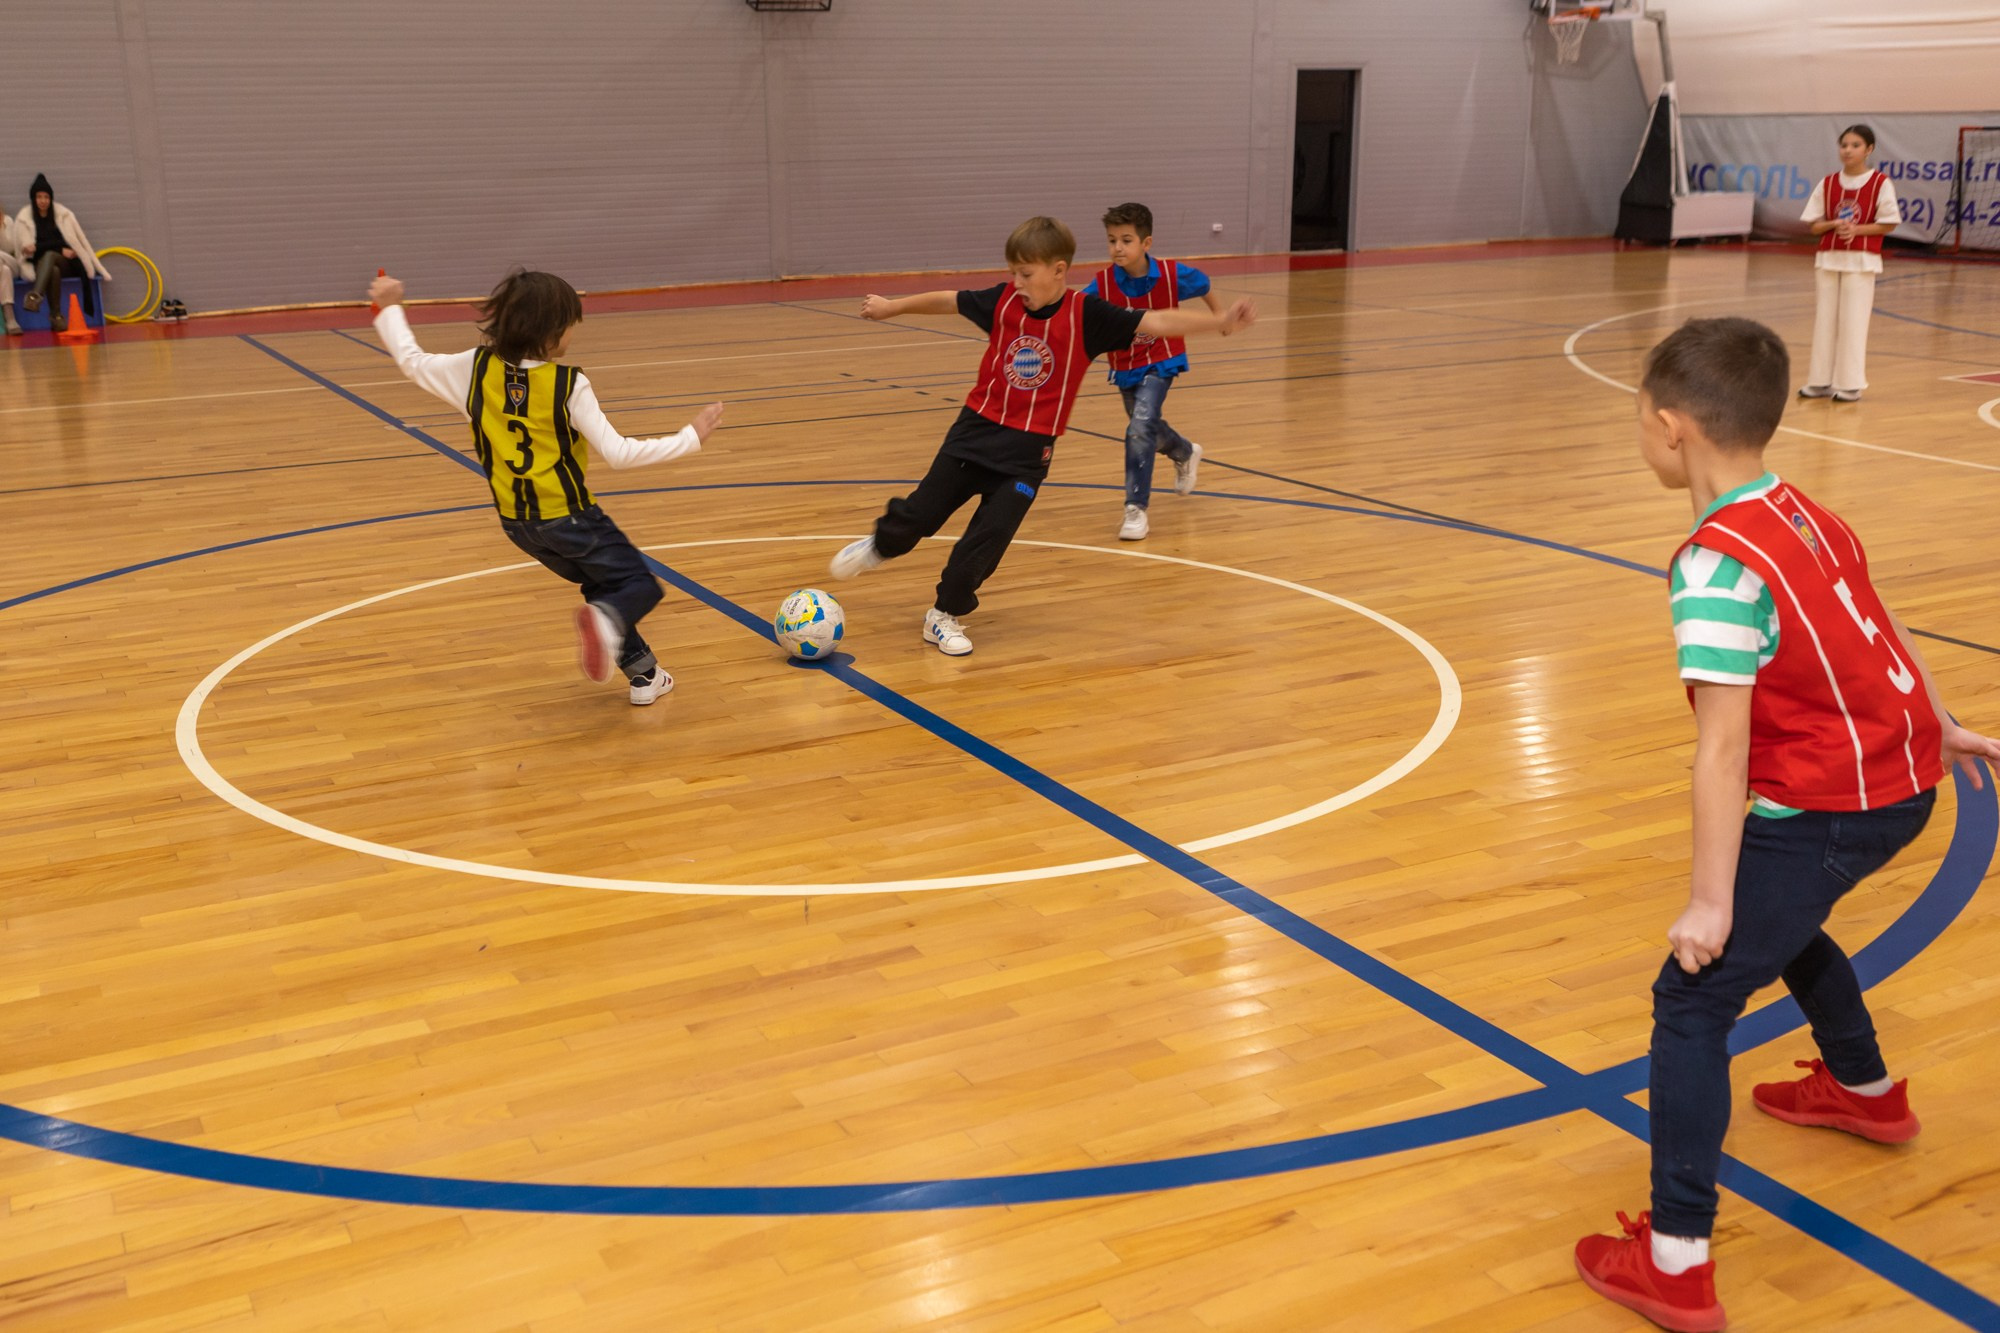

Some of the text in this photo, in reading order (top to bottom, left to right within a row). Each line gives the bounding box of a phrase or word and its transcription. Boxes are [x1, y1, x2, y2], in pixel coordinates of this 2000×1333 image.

[1879, 156, 2000, 181] russat.r
[504, 419, 534, 476] 3
[1832, 576, 1916, 695] 5
